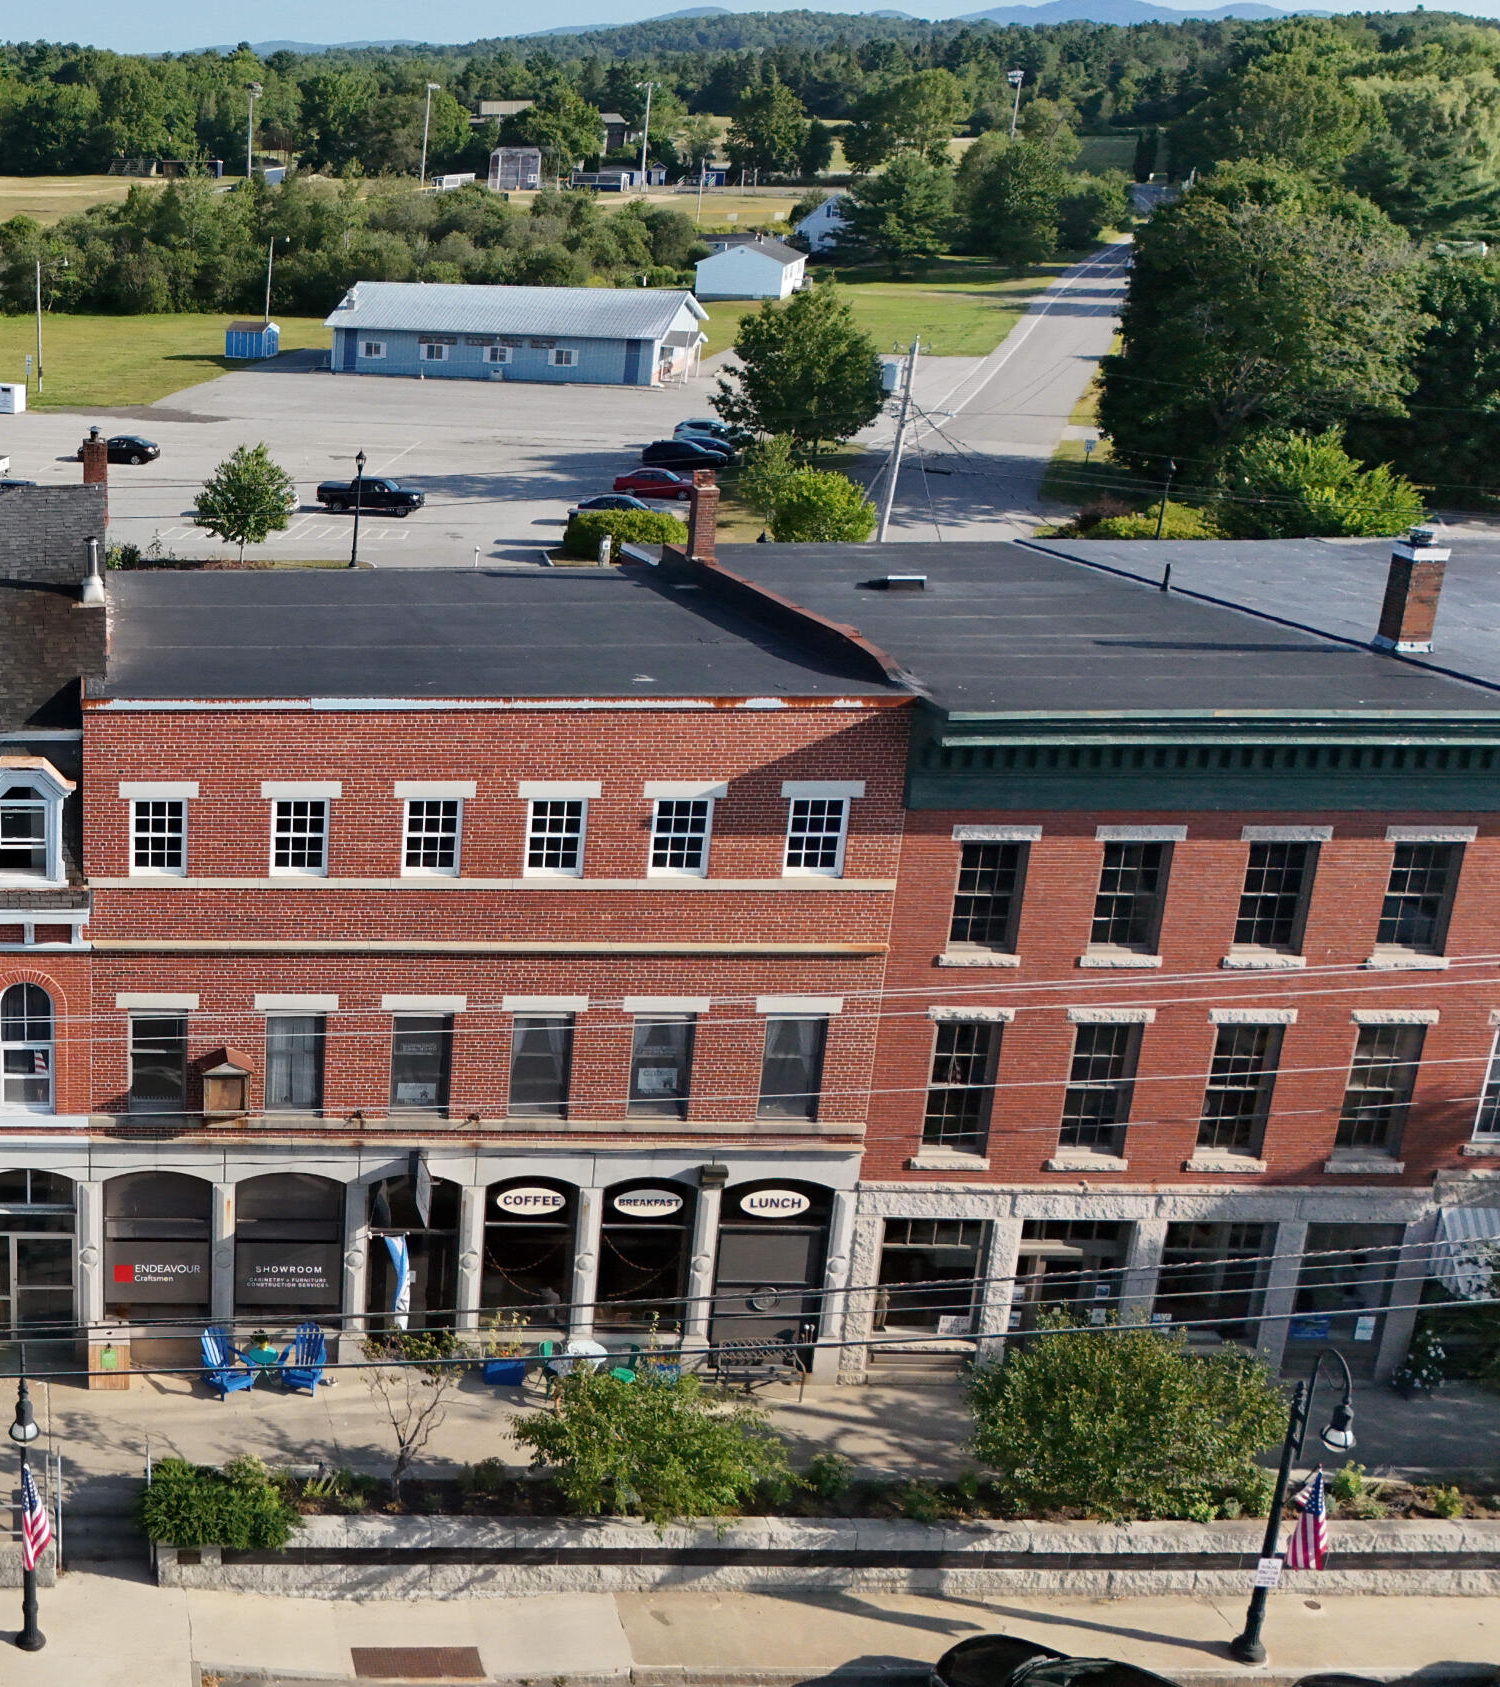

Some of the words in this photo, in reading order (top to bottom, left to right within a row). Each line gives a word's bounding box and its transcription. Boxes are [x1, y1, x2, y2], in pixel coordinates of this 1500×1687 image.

[502, 1195, 562, 1207] COFFEE
[617, 1199, 680, 1208] BREAKFAST
[749, 1198, 803, 1210] LUNCH
[134, 1265, 201, 1274] ENDEAVOUR
[255, 1266, 322, 1274] SHOWROOM
[134, 1275, 174, 1283] Craftsmen
